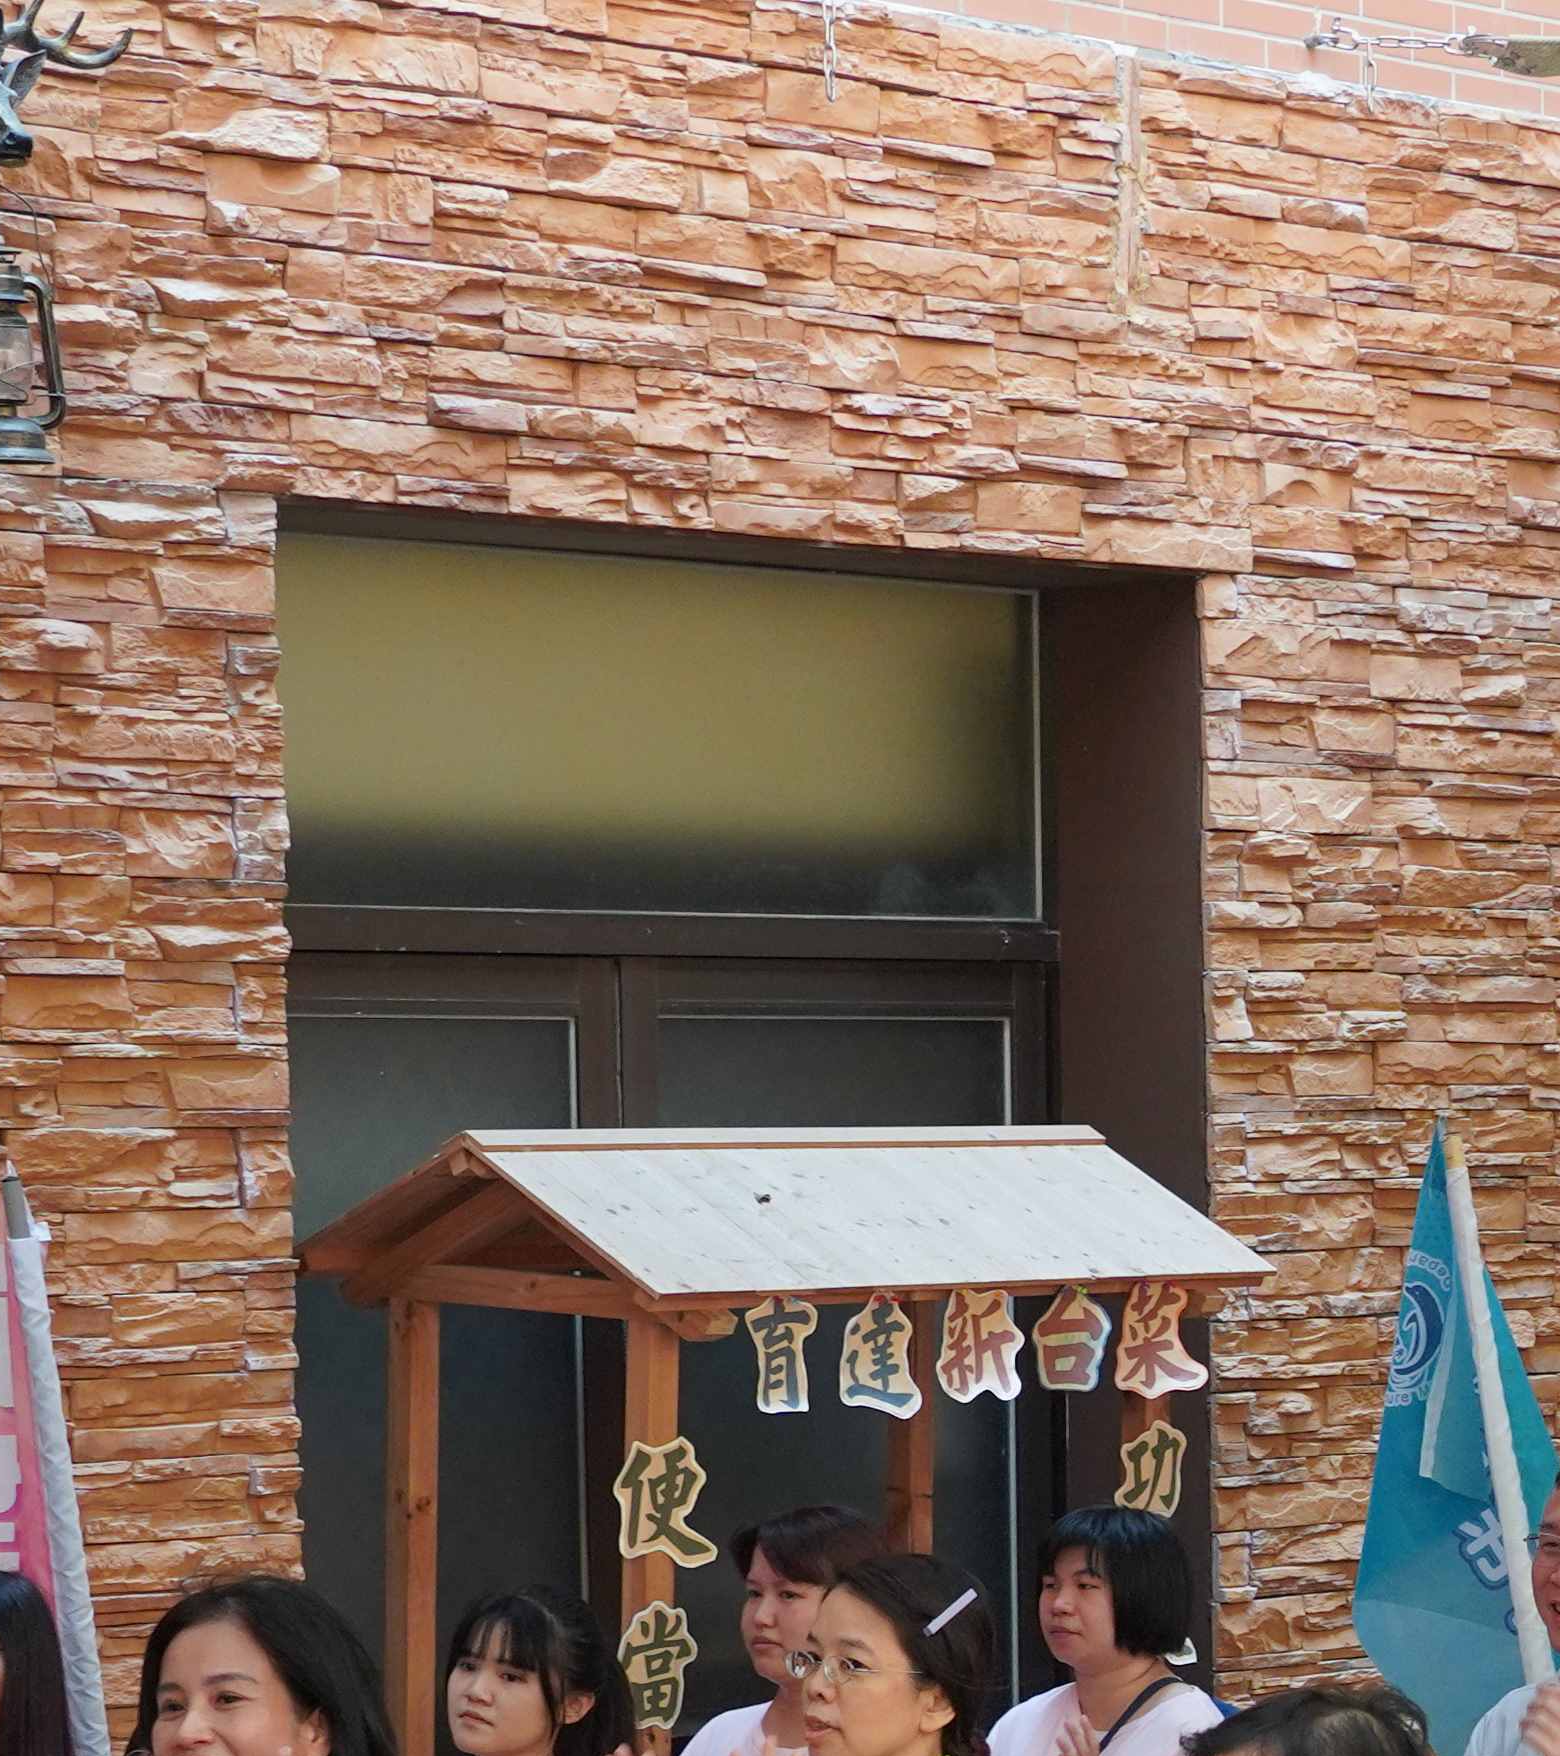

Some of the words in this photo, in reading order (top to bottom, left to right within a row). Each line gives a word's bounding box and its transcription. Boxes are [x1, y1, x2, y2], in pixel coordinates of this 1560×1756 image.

[750, 1284, 1206, 1415] 育達新台菜
[620, 1445, 714, 1721] 便當
